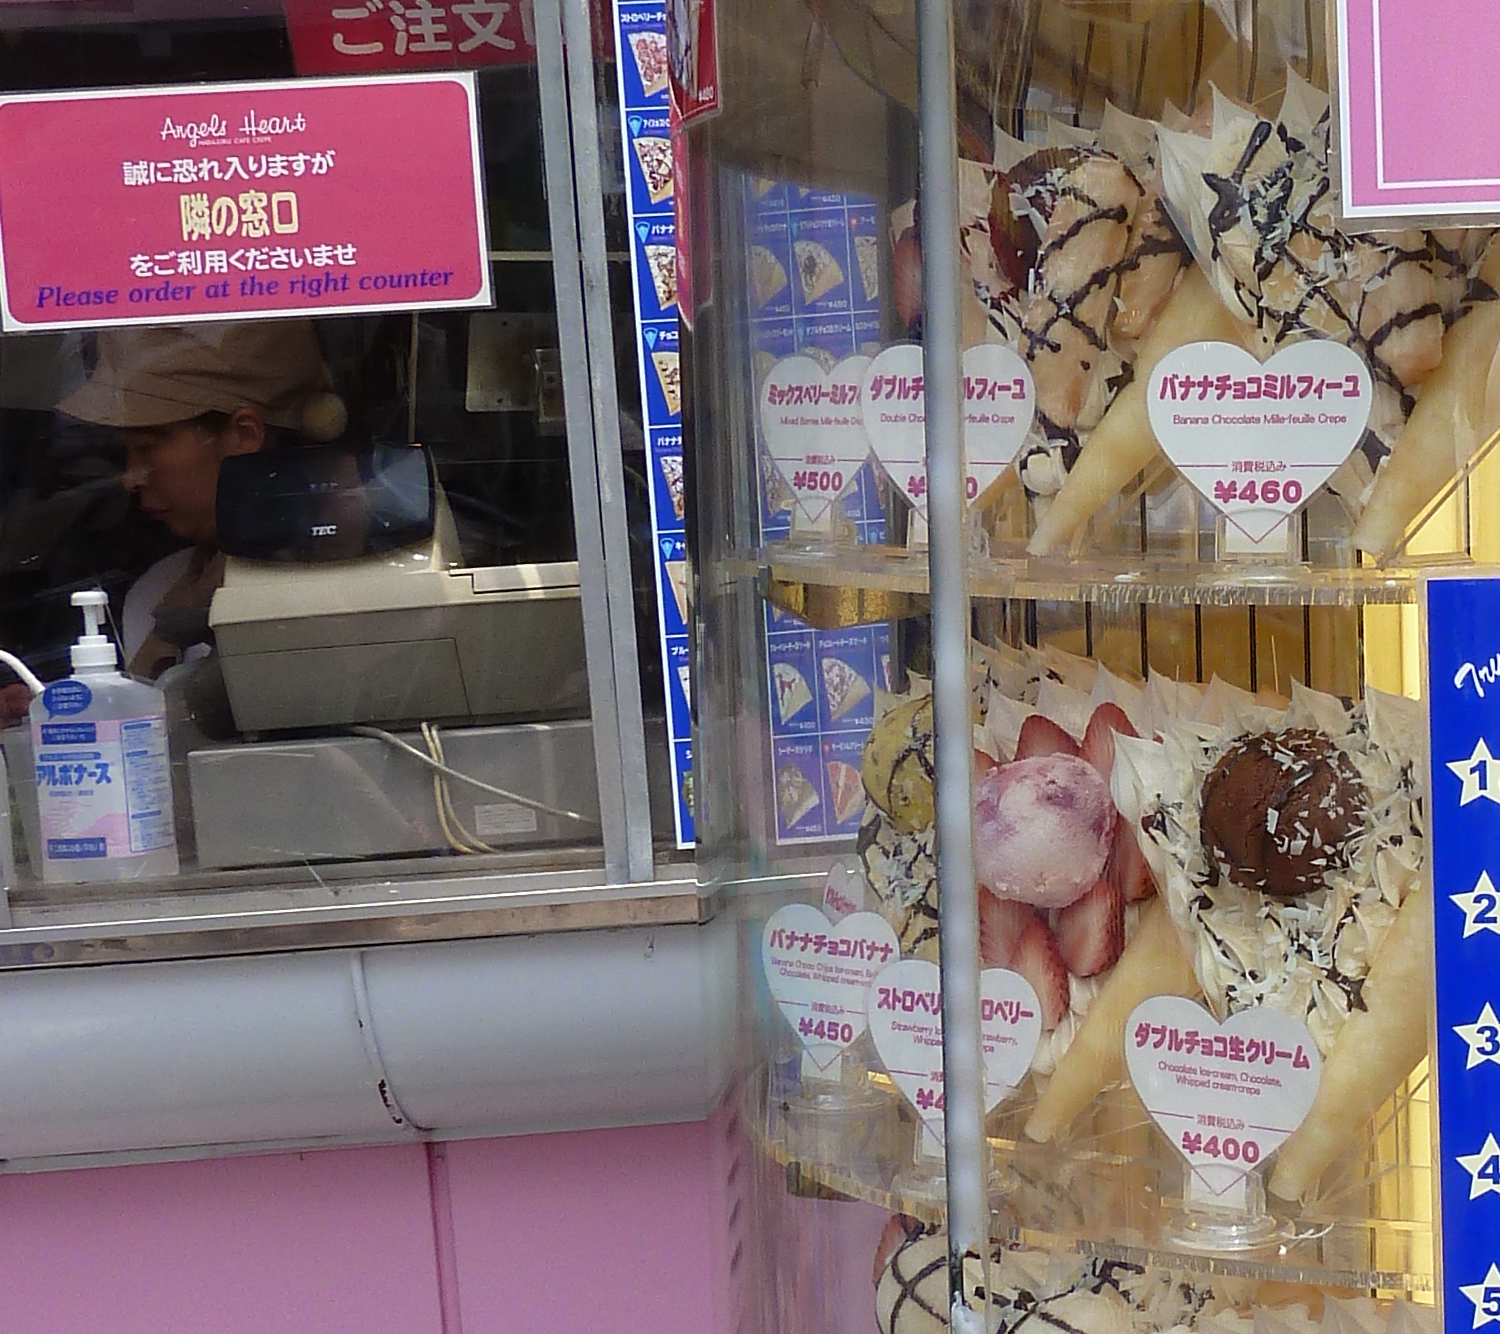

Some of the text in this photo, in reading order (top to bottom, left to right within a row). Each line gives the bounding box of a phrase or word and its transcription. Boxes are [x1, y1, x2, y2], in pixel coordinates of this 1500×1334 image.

[160, 109, 307, 149] Angels Heart
[122, 149, 337, 187] 誠に恐れ入りますが
[179, 188, 301, 242] 隣の窓口
[129, 243, 357, 279] をご利用くださいませ
[36, 267, 454, 309] Please order at the right counter
[1159, 372, 1361, 402] バナナチョコミルフィーユ
[880, 412, 907, 424] Double
[1173, 413, 1210, 426] Banana
[1211, 413, 1261, 425] Chocolate
[1318, 413, 1347, 424] Crepe
[793, 470, 844, 492] ¥500
[1231, 460, 1288, 473] 消費税込み
[1214, 479, 1303, 505] ¥460
[311, 524, 338, 537] TEC
[1468, 759, 1489, 791] 1
[1471, 893, 1498, 925] 2
[769, 927, 894, 963] バナナチョコバナナ
[798, 1016, 854, 1044] ¥450
[1134, 1022, 1311, 1070] ダブルチョコ生クリーム
[1475, 1024, 1500, 1056] 3
[1158, 1060, 1198, 1076] Chocolate
[1175, 1073, 1211, 1089] Whipped
[1182, 1131, 1260, 1164] ¥400
